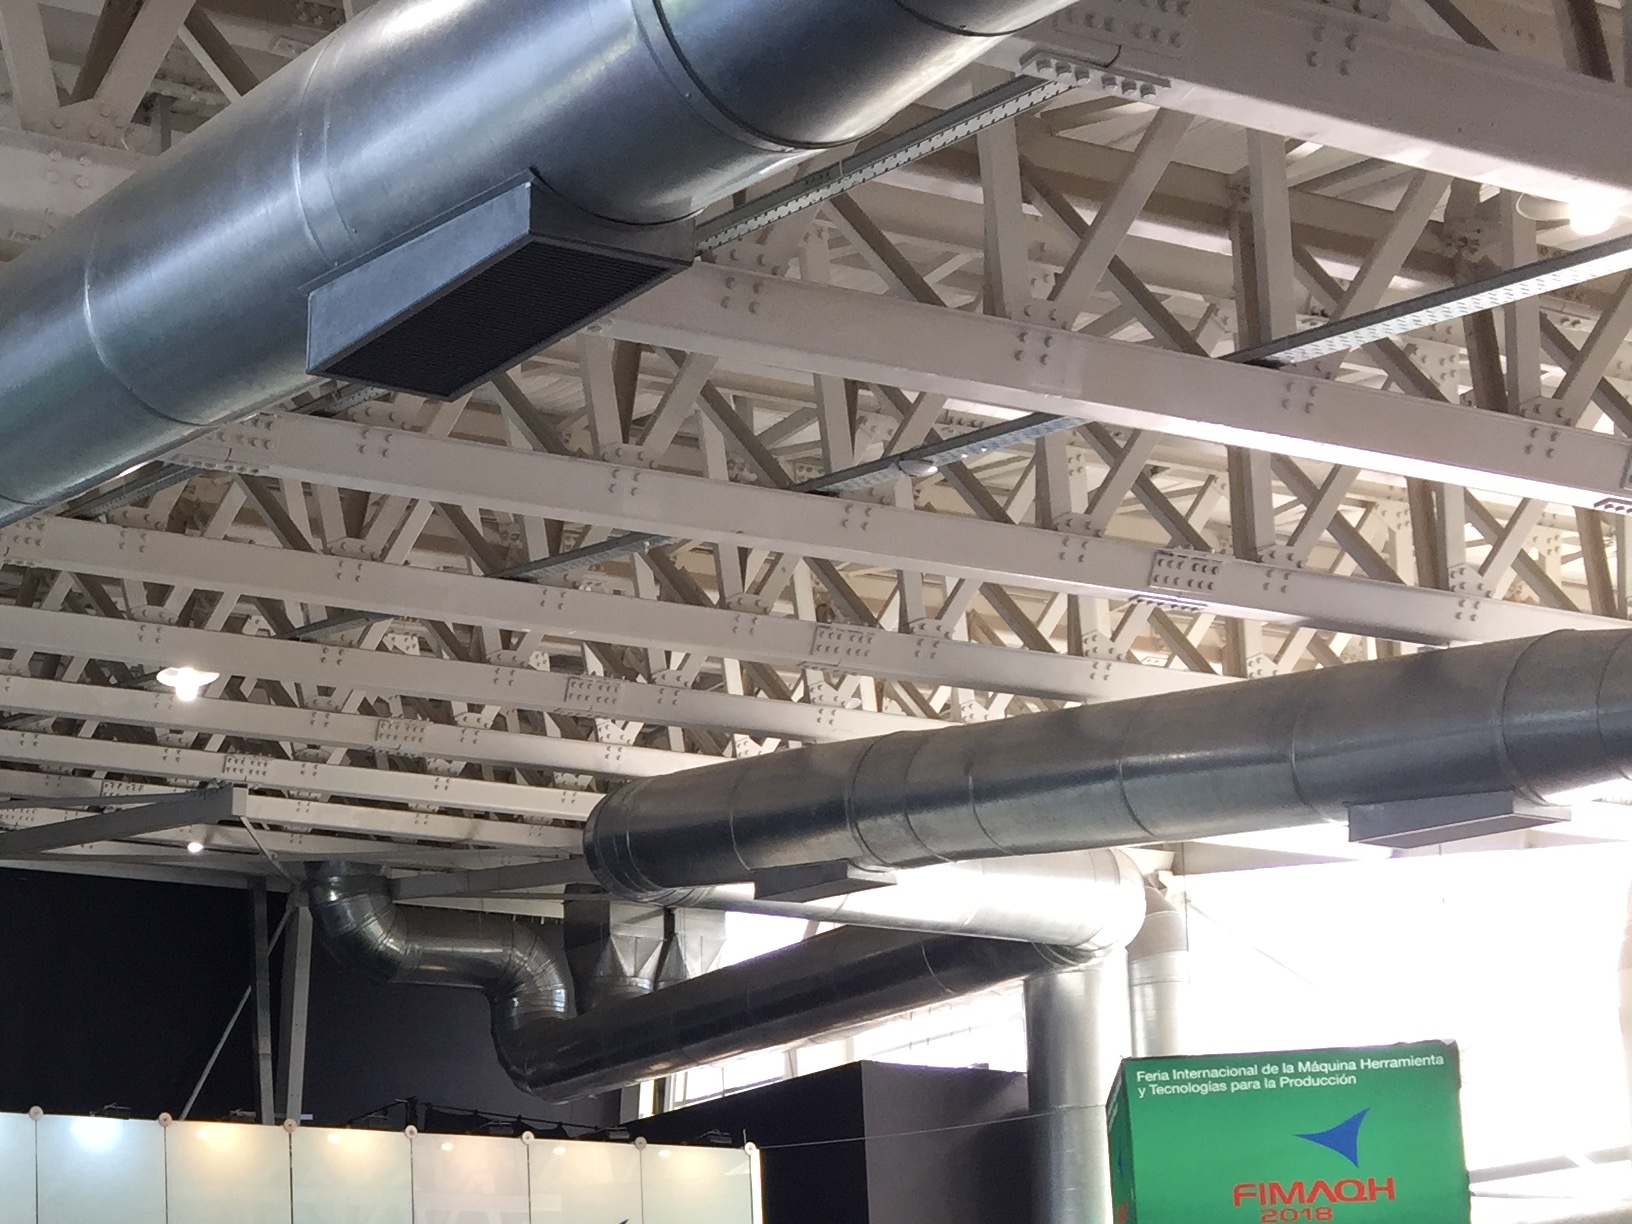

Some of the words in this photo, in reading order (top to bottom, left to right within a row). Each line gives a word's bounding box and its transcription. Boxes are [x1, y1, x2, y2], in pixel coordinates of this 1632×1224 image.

[1136, 1070, 1170, 1082] Feria
[1172, 1064, 1258, 1080] Internacional
[1261, 1063, 1279, 1075] de
[1282, 1062, 1295, 1074] la
[1298, 1059, 1357, 1074] Máquina
[1360, 1053, 1445, 1070] Herramienta
[1137, 1086, 1146, 1098] y
[1149, 1081, 1228, 1095] Tecnologías
[1230, 1079, 1262, 1093] para
[1264, 1078, 1277, 1089] la
[1279, 1074, 1357, 1088] Producción
[1260, 1206, 1334, 1224] 2018
